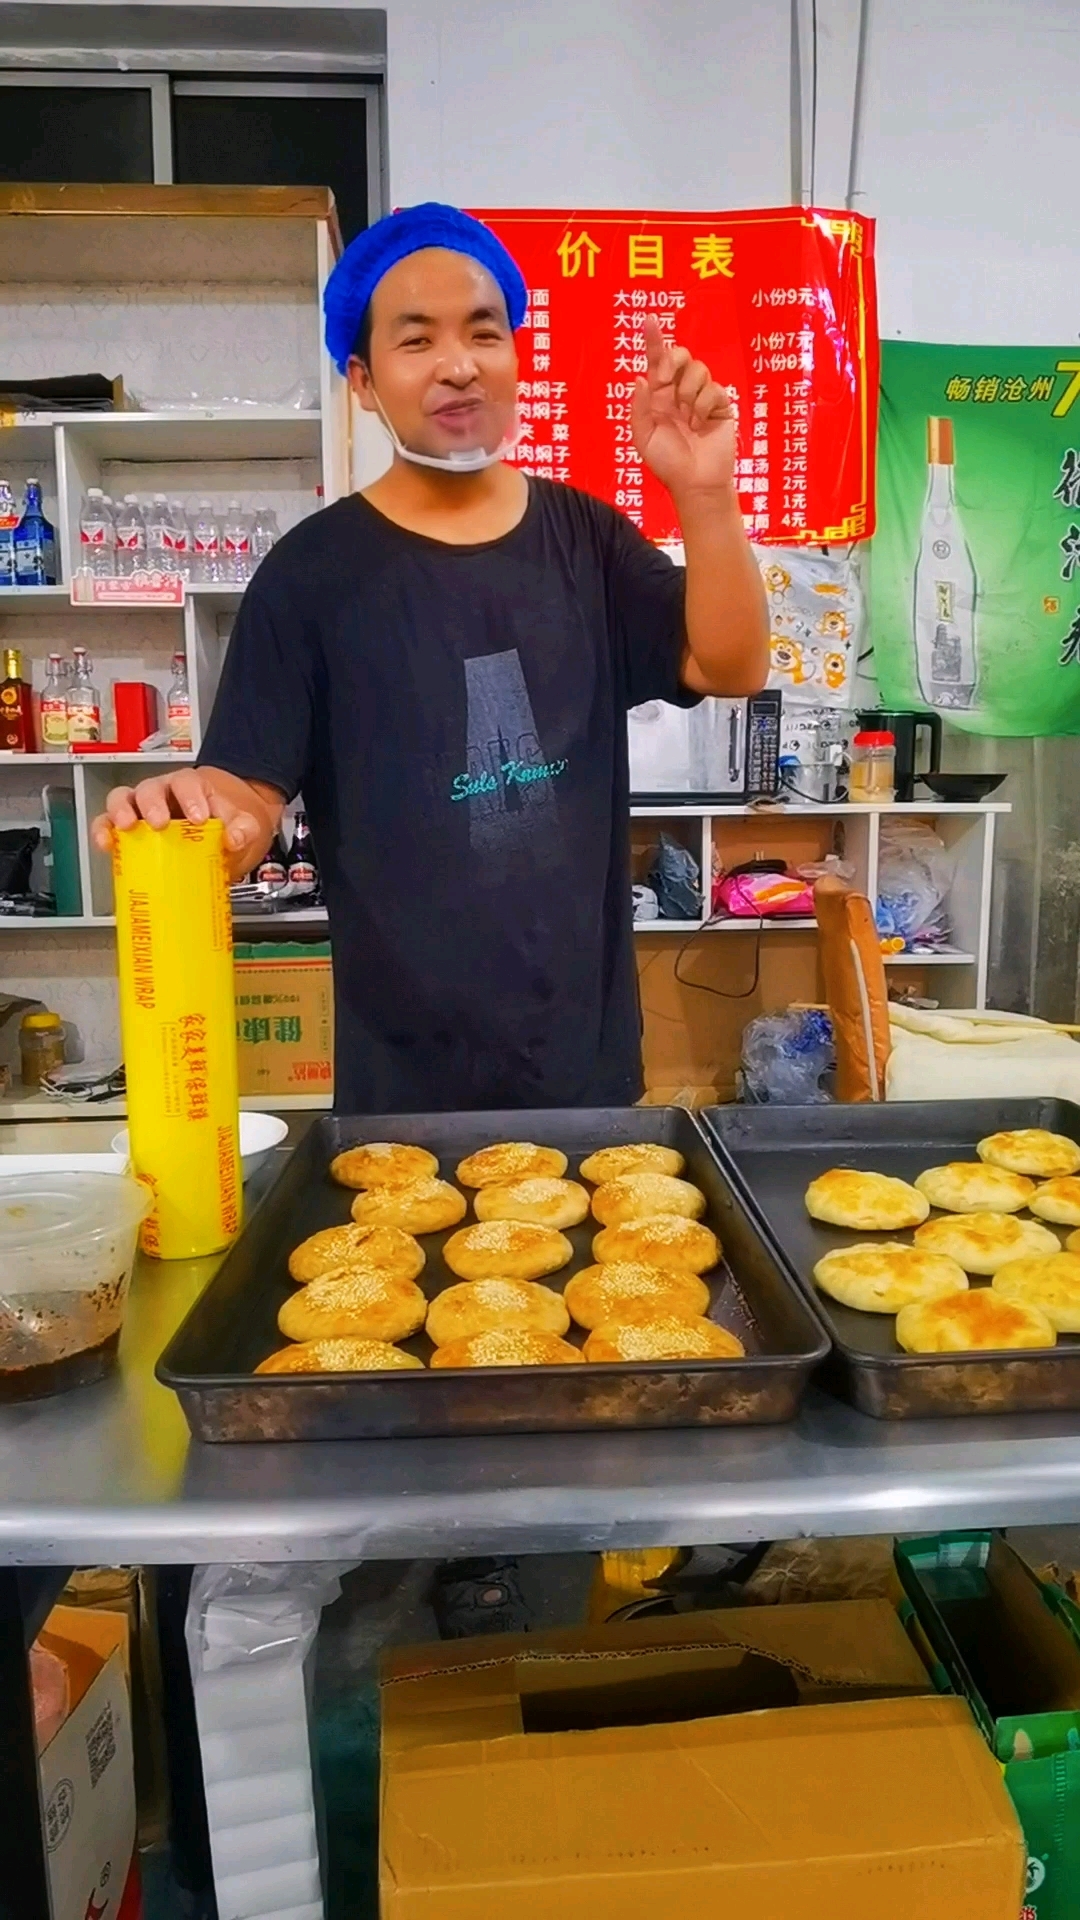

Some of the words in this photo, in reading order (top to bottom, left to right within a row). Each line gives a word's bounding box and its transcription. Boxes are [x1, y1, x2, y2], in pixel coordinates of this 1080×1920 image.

[557, 231, 735, 279] 价目表
[613, 290, 685, 308] 大份10元
[752, 288, 815, 307] 小份9元
[533, 333, 550, 350] 面
[613, 332, 677, 351] 大份元
[750, 332, 814, 351] 小份7元
[532, 354, 550, 371] 饼
[516, 381, 568, 399] 肉焖子
[783, 382, 808, 397] 1元
[946, 375, 1054, 402] 畅销沧州
[515, 402, 568, 420] 肉焖子
[783, 400, 808, 416] 1元
[783, 419, 808, 435] 1元
[783, 438, 807, 453] 1元
[615, 446, 643, 464] 5元
[783, 456, 807, 472] 2元
[615, 468, 643, 485] 7元
[783, 475, 807, 490] 2元
[615, 489, 643, 506] 8元
[783, 493, 807, 509] 1元
[781, 512, 806, 527] 4元
[129, 889, 153, 973] JIAJIAMEIXIAN
[134, 977, 156, 1010] WRAP
[237, 1016, 302, 1044] 健康
